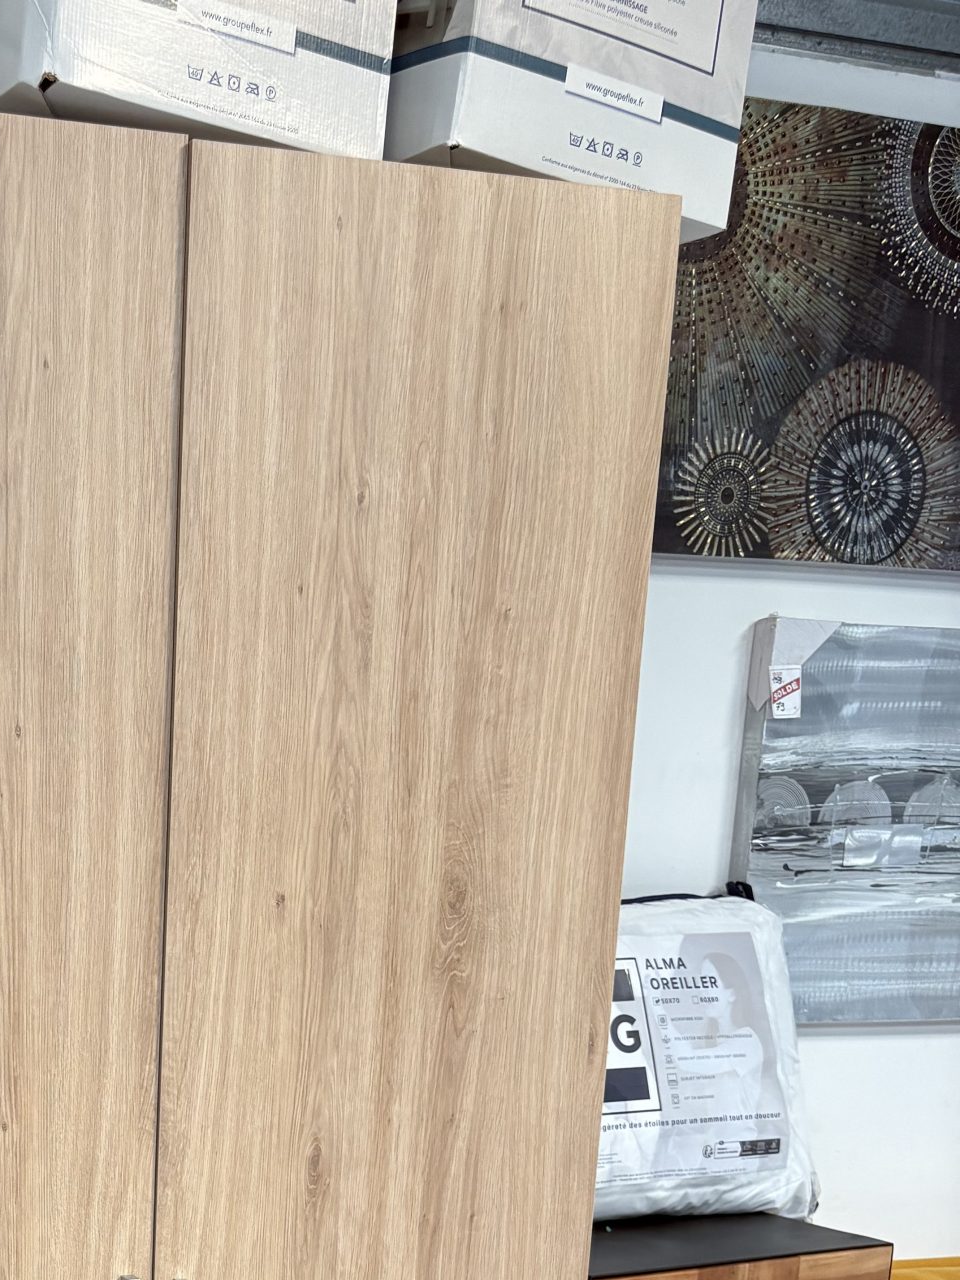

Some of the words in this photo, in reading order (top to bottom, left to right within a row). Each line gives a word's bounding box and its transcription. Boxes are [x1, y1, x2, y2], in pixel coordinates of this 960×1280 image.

[201, 9, 272, 38] www.groupeflex.fr
[585, 80, 644, 107] www.groupeflex.fr
[773, 681, 799, 701] SOLDE
[645, 956, 687, 970] ALMA
[649, 976, 719, 990] OREILLER
[610, 1014, 642, 1053] G
[628, 1121, 642, 1129] des
[644, 1119, 670, 1128] étoiles
[671, 1118, 688, 1127] pour
[699, 1114, 728, 1124] sommeil
[729, 1113, 743, 1122] tout
[754, 1111, 781, 1120] douceur
